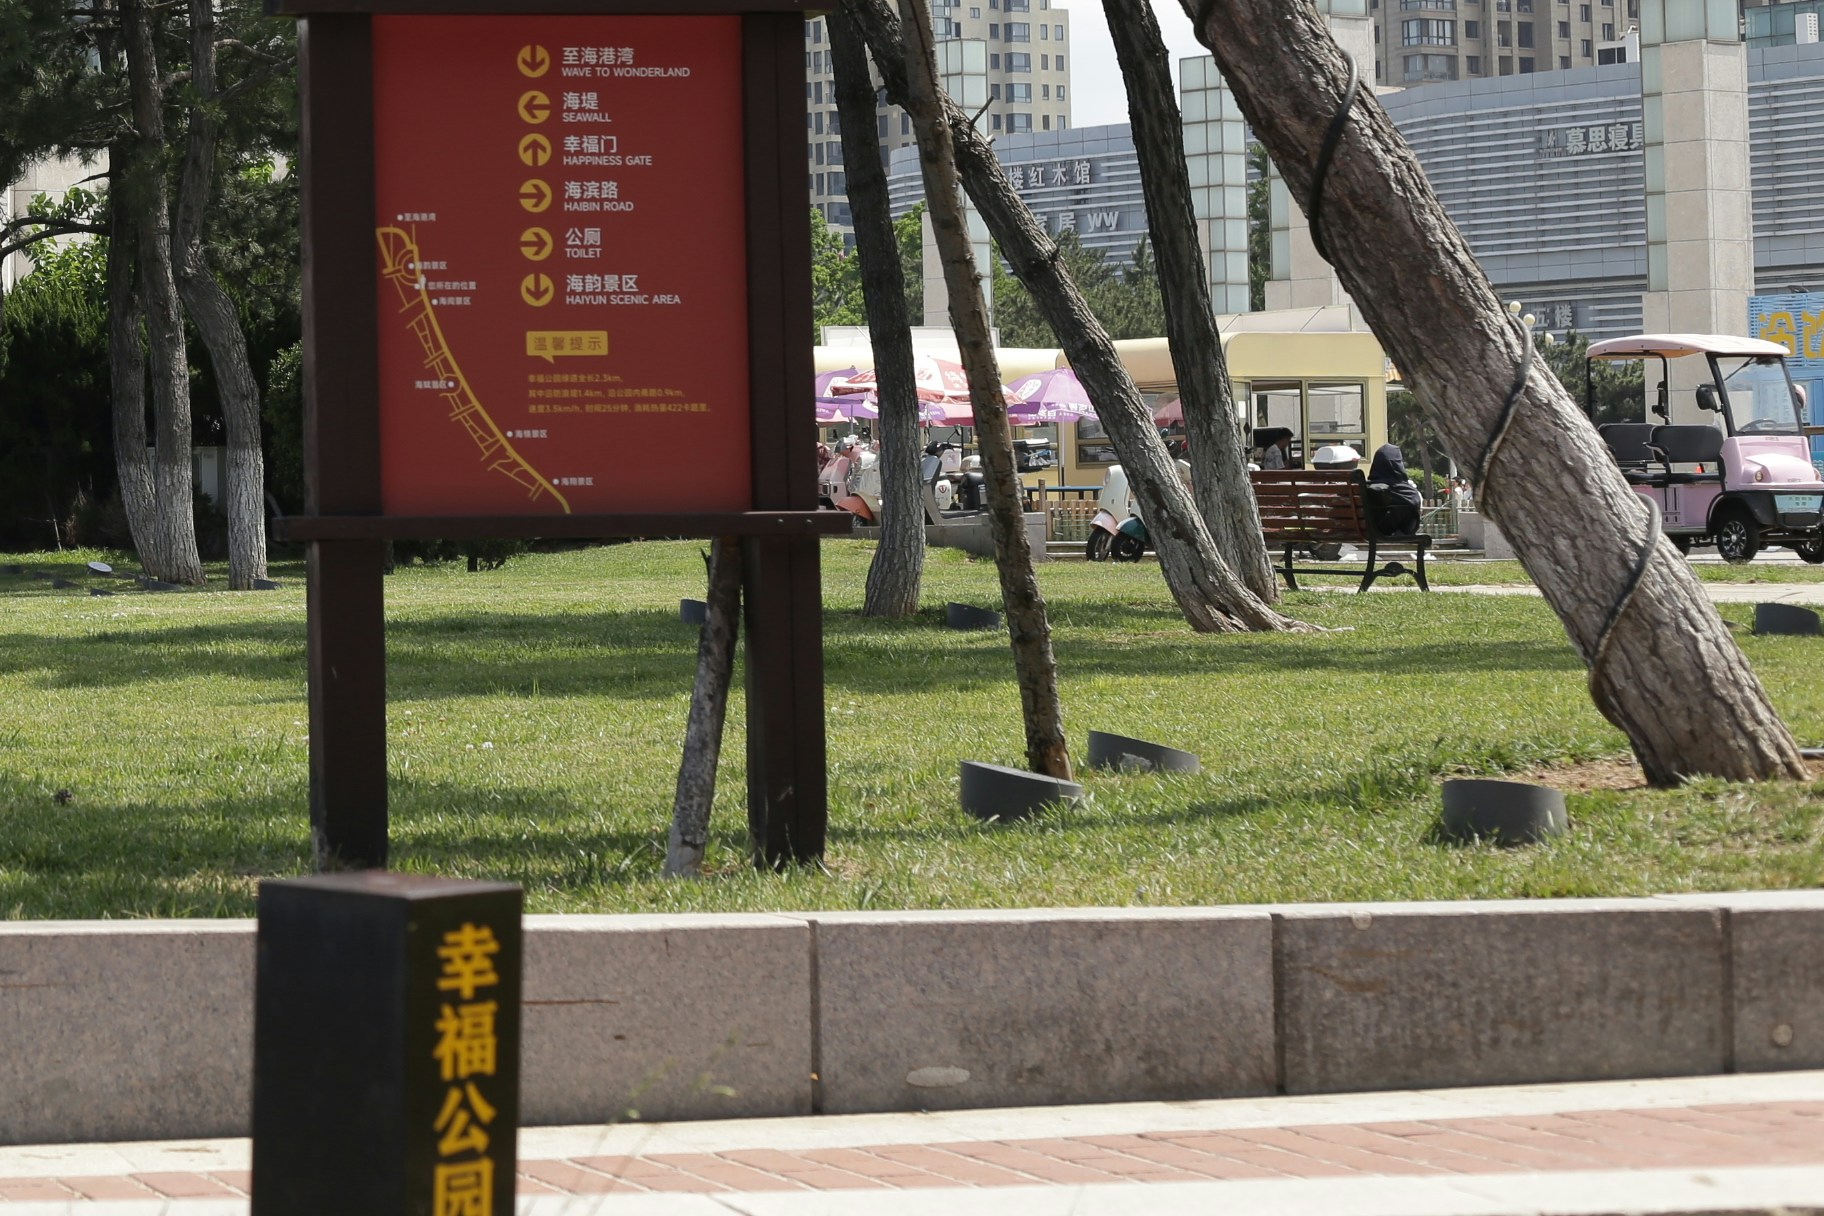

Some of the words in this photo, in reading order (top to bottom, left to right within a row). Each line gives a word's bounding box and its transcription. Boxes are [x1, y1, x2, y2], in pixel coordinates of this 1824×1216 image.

[562, 47, 634, 65] 至海港湾
[562, 67, 592, 77] WAVE
[595, 67, 610, 77] TO
[613, 67, 691, 77] WONDERLAND
[563, 92, 599, 110] 海堤
[562, 112, 612, 122] SEAWALL
[563, 135, 617, 153] 幸福门
[563, 155, 622, 165] HAPPINESS
[625, 155, 653, 166] GATE
[564, 181, 618, 199] 海滨路
[564, 201, 600, 211] HAIBIN
[603, 201, 634, 211] ROAD
[565, 227, 601, 246] 公厕
[565, 248, 602, 258] TOILET
[566, 274, 639, 292] 海韵景区
[565, 295, 606, 304] HAIYUN
[610, 295, 649, 304] SCENIC
[652, 294, 681, 304] AREA
[534, 336, 602, 351] 温馨提示
[433, 922, 500, 1216] 幸福公园
